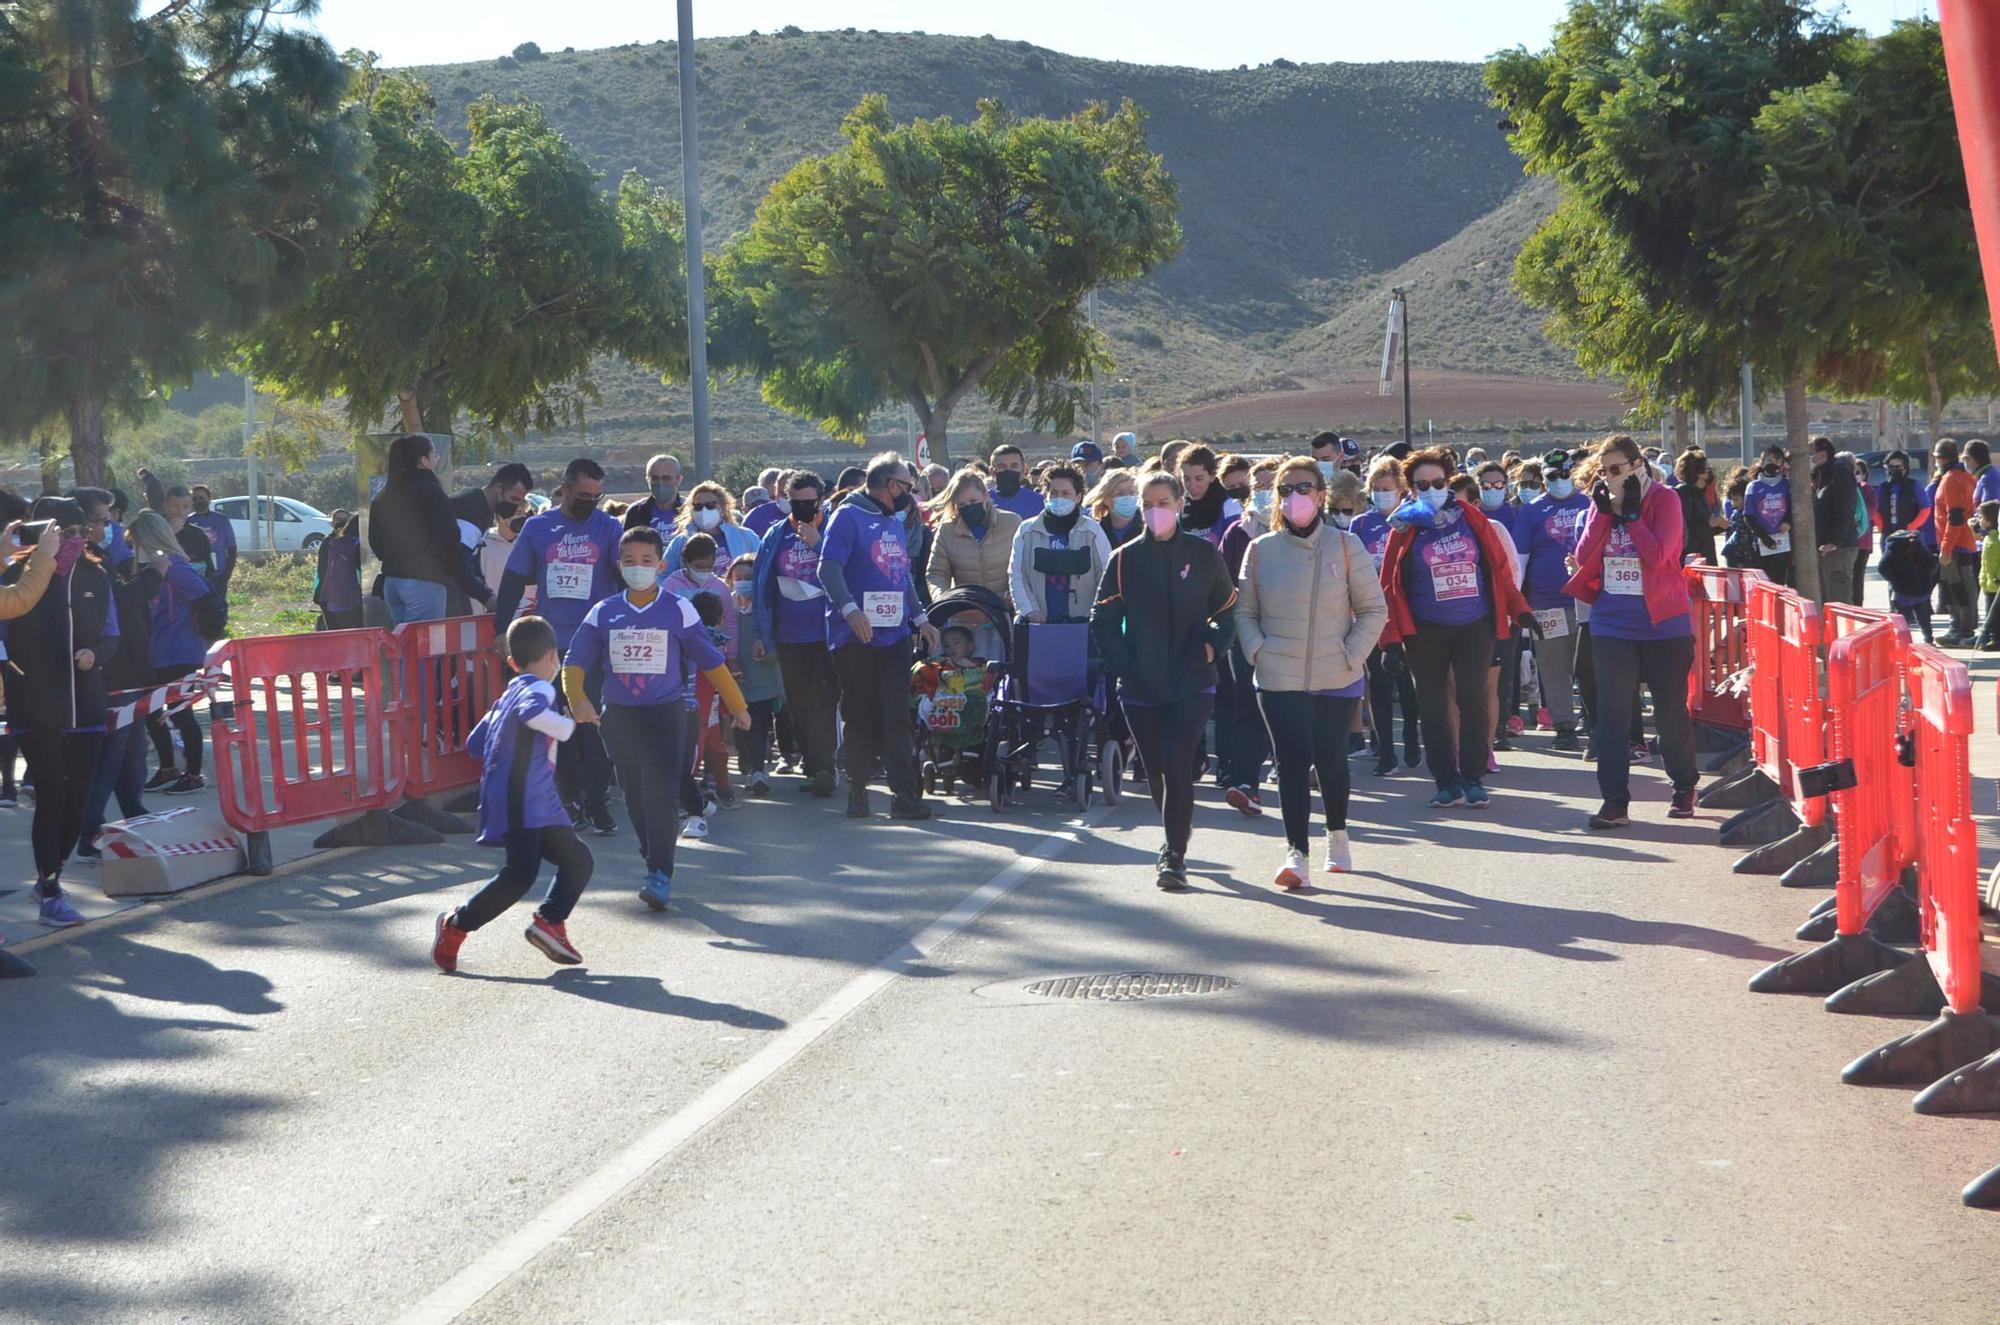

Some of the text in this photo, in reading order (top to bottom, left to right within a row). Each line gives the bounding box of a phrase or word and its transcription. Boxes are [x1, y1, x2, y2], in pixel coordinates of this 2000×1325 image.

[919, 447, 931, 459] 40
[556, 575, 579, 586] 371
[1446, 574, 1468, 587] 034
[1615, 570, 1640, 581] 369
[876, 604, 897, 614] 630
[623, 645, 653, 657] 372
